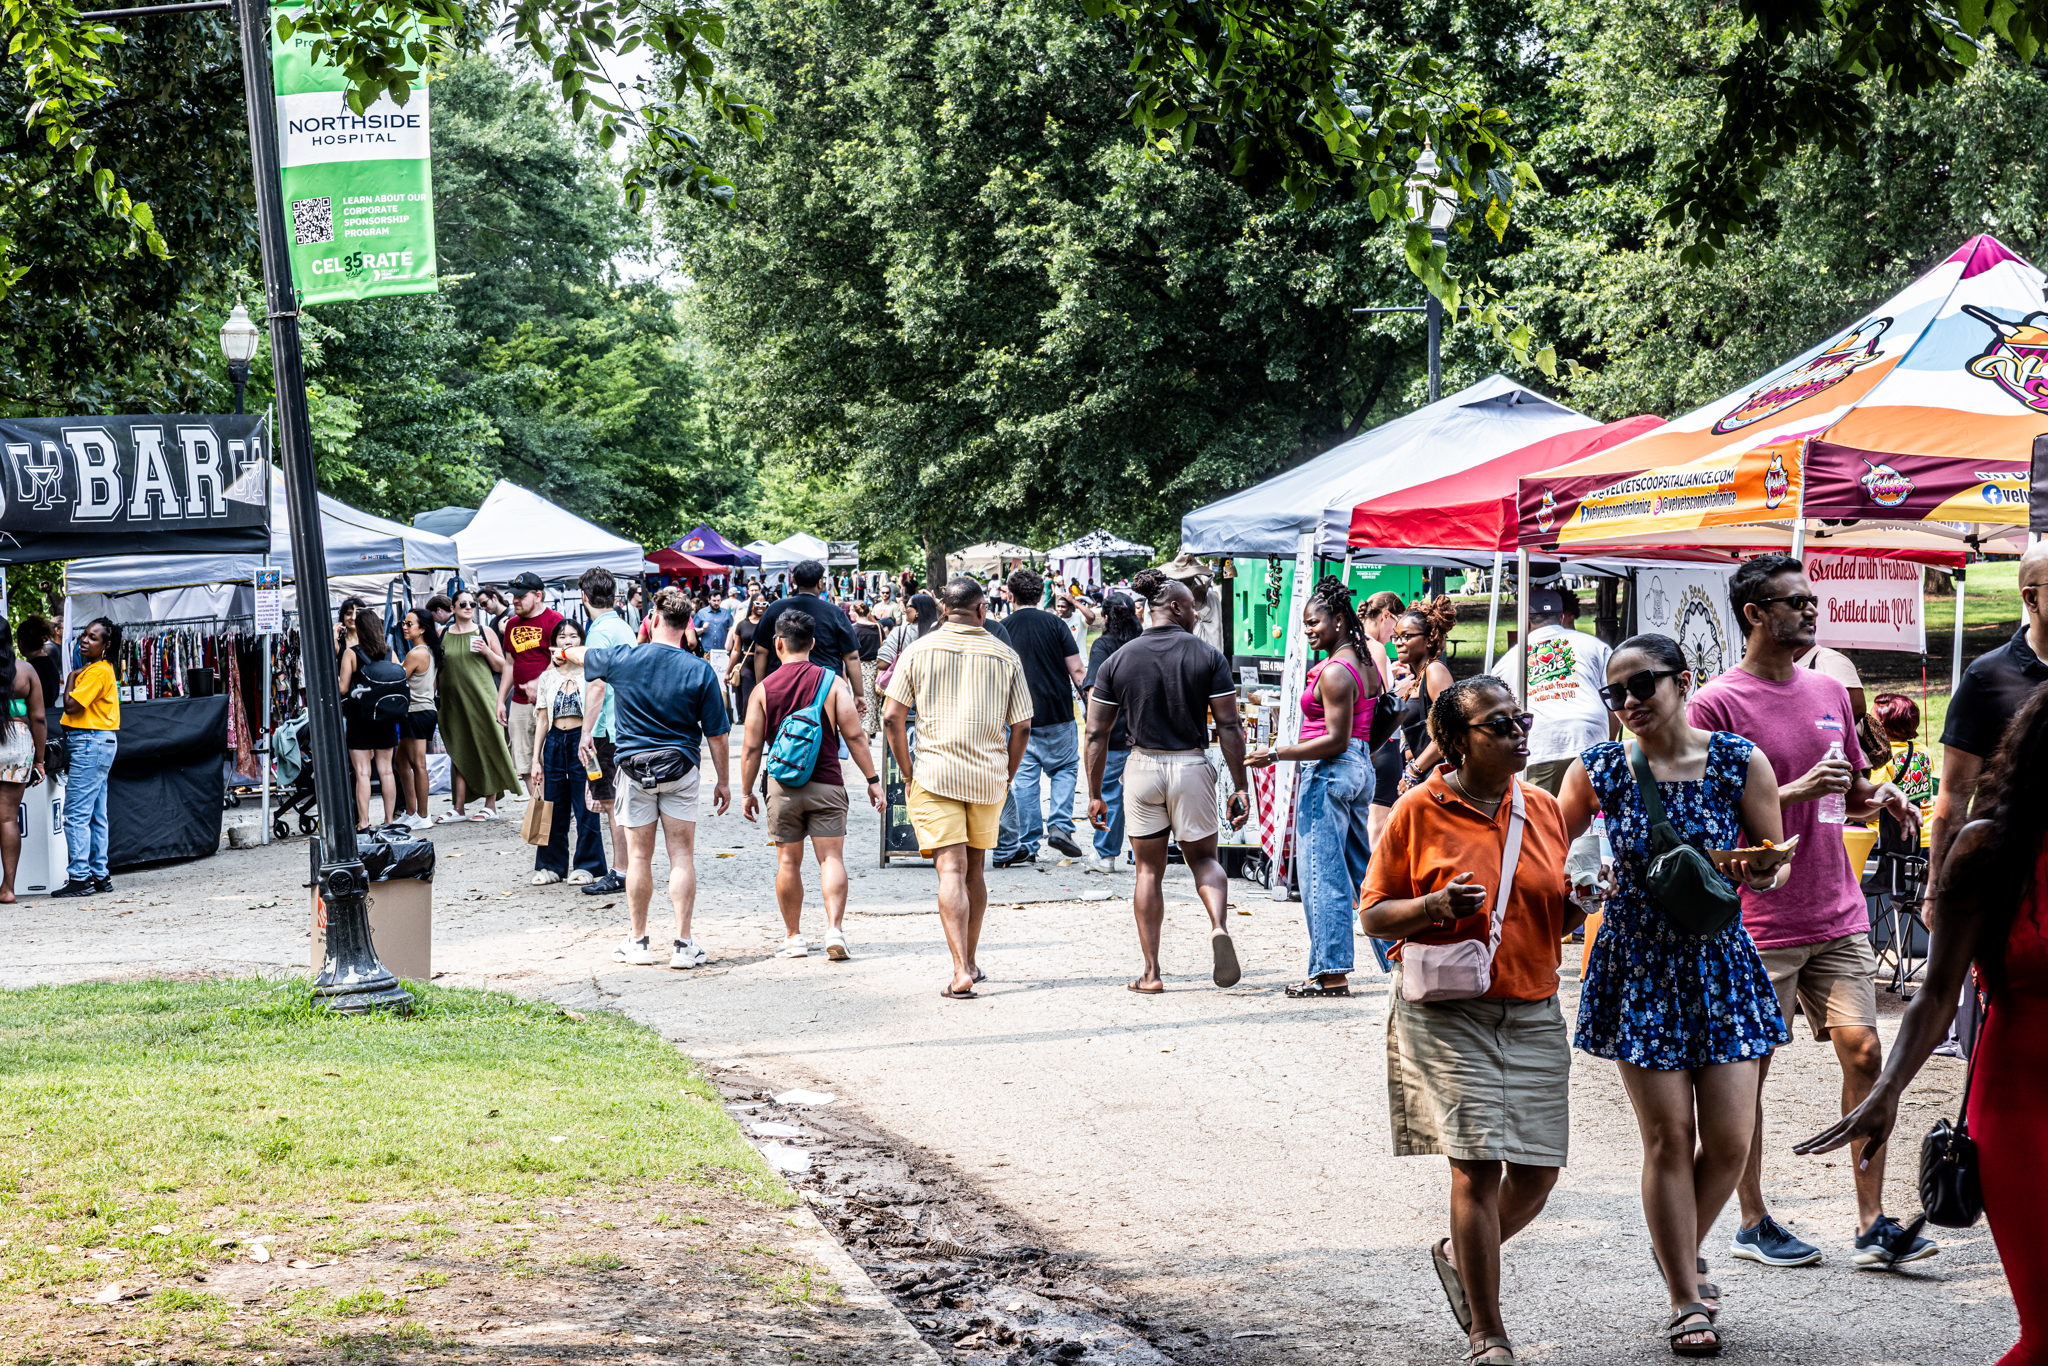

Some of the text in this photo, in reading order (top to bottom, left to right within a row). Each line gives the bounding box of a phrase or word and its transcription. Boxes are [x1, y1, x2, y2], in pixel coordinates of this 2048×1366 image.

[289, 114, 421, 135] NORTHSIDE
[312, 132, 397, 146] HOSPITAL
[343, 193, 427, 205] LEARN ABOUT OUR
[343, 205, 398, 216] CORPORATE
[344, 215, 410, 227] SPONSORSHIP
[344, 227, 390, 238] PROGRAM
[61, 424, 228, 523] BAR
[1861, 474, 1910, 489] Velvet
[1870, 483, 1914, 499] Scoops
[1858, 557, 1878, 580] with
[1828, 597, 1867, 623] Bottled
[1870, 599, 1890, 623] with
[1270, 661, 1274, 671] 4
[1528, 660, 1566, 683] Love
[1902, 782, 1929, 797] Love
